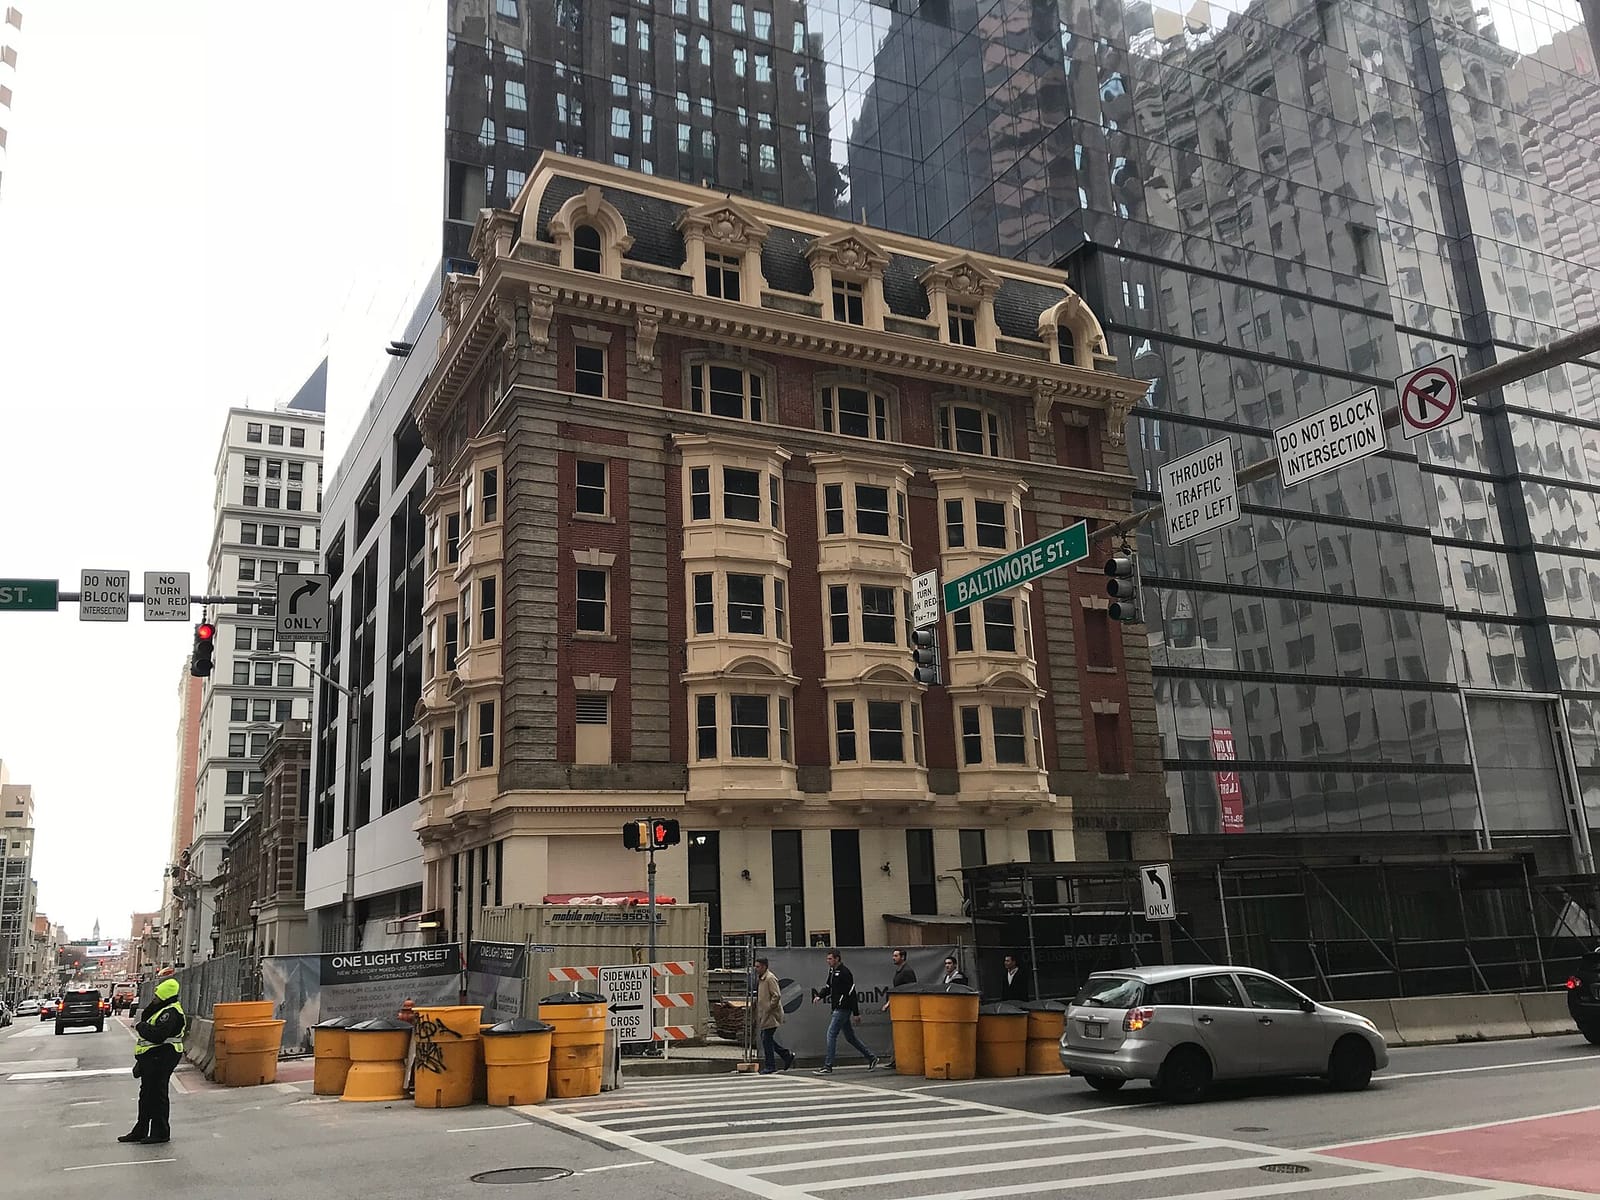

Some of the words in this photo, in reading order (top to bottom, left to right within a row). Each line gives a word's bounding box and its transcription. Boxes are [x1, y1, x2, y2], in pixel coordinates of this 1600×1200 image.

[1280, 432, 1298, 452] DO
[1302, 419, 1327, 444] NOT
[1330, 399, 1375, 432] BLOCK
[1287, 426, 1377, 476] INTERSECTION
[1169, 451, 1224, 487] THROUGH
[1175, 476, 1222, 508] TRAFFIC
[1170, 507, 1200, 533] KEEP
[1205, 495, 1233, 520] LEFT
[957, 548, 1044, 602] BALTIMORE
[1047, 540, 1070, 562] ST.
[84, 575, 100, 587] DO
[105, 576, 127, 588] NOT
[159, 576, 176, 585] NO
[918, 578, 928, 588] NO
[0, 587, 33, 603] ST.
[84, 591, 126, 603] BLOCK
[154, 587, 181, 596] TURN
[917, 588, 931, 599] TURN
[146, 597, 162, 606] ON
[167, 597, 188, 606] RED
[923, 597, 937, 609] RED
[82, 606, 126, 616] INTERSECTION
[284, 617, 322, 629] ONLY
[552, 909, 582, 921] mobile
[583, 911, 603, 921] mini
[1149, 903, 1170, 916] ONLY
[332, 956, 362, 969] ONE
[364, 952, 401, 966] LIGHT
[404, 949, 450, 964] STREET
[408, 962, 445, 971] DEVELOPMENT
[603, 969, 648, 982] SIDEWALK
[608, 980, 642, 992] CLOSED
[610, 991, 641, 1002] AHEAD
[610, 1015, 640, 1027] CROSS
[620, 1027, 637, 1038] ERE
